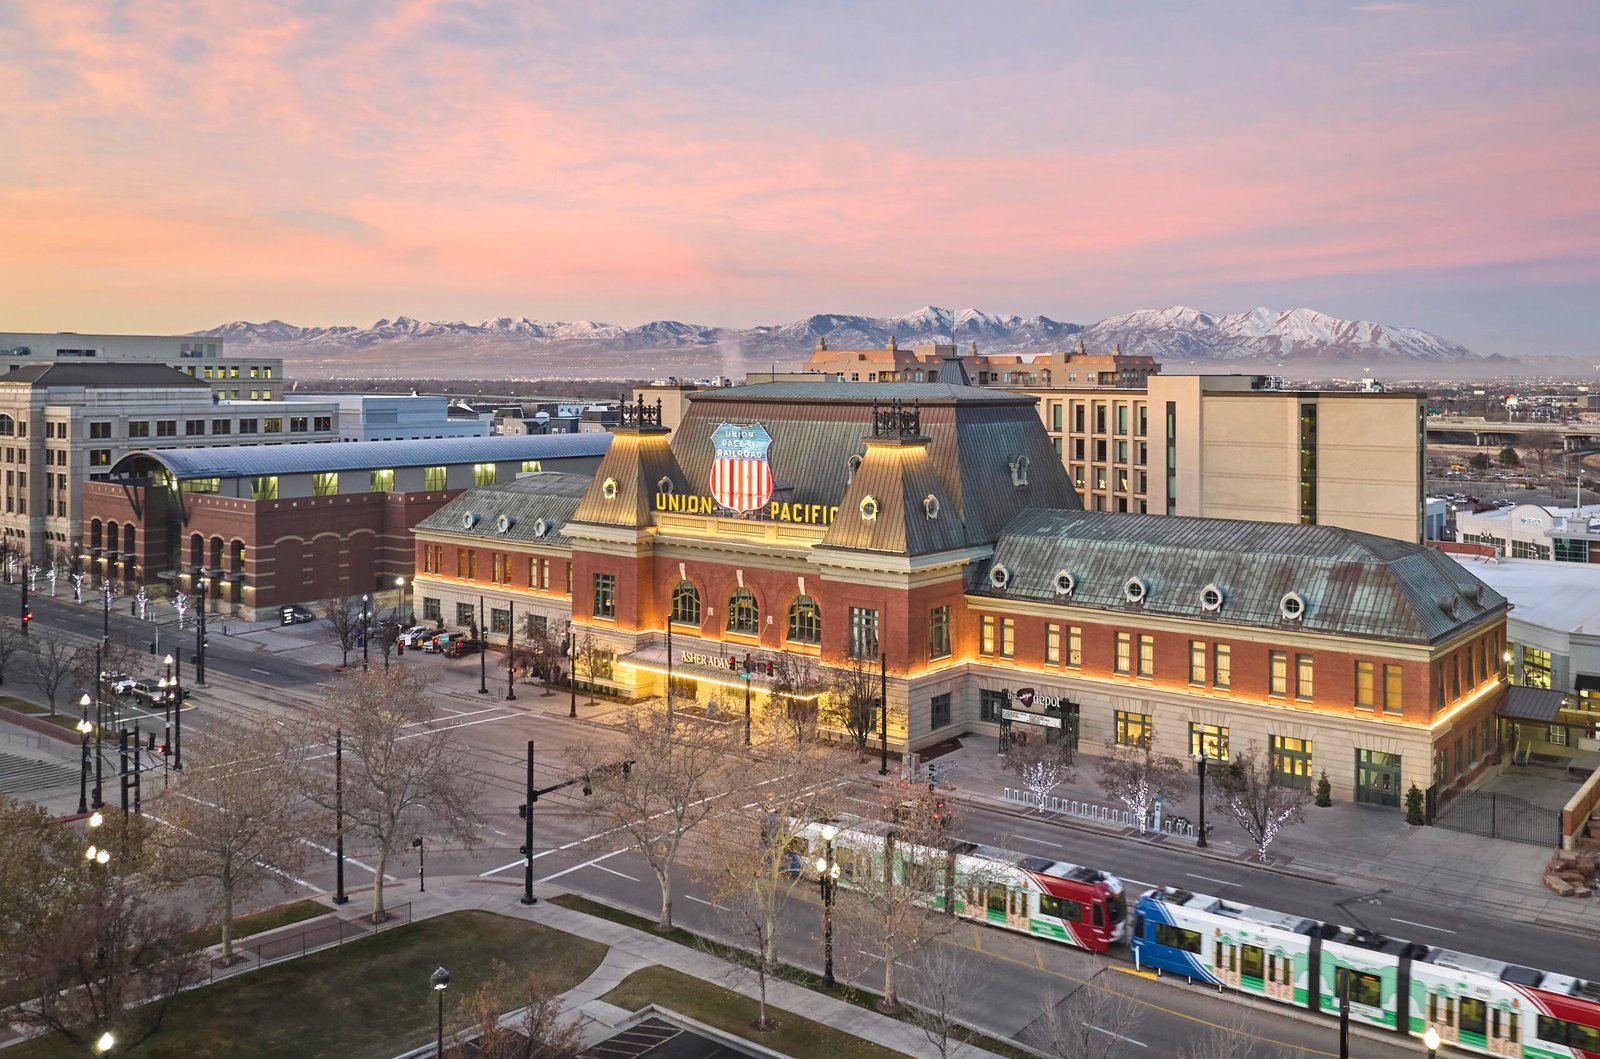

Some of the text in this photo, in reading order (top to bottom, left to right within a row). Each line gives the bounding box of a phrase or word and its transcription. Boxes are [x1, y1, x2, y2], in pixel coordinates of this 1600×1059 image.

[725, 430, 754, 438] UNION
[717, 448, 762, 459] RAILROAD
[656, 493, 838, 524] UNION PACIFIC
[681, 652, 707, 665] ASHER
[1033, 691, 1061, 708] depot
